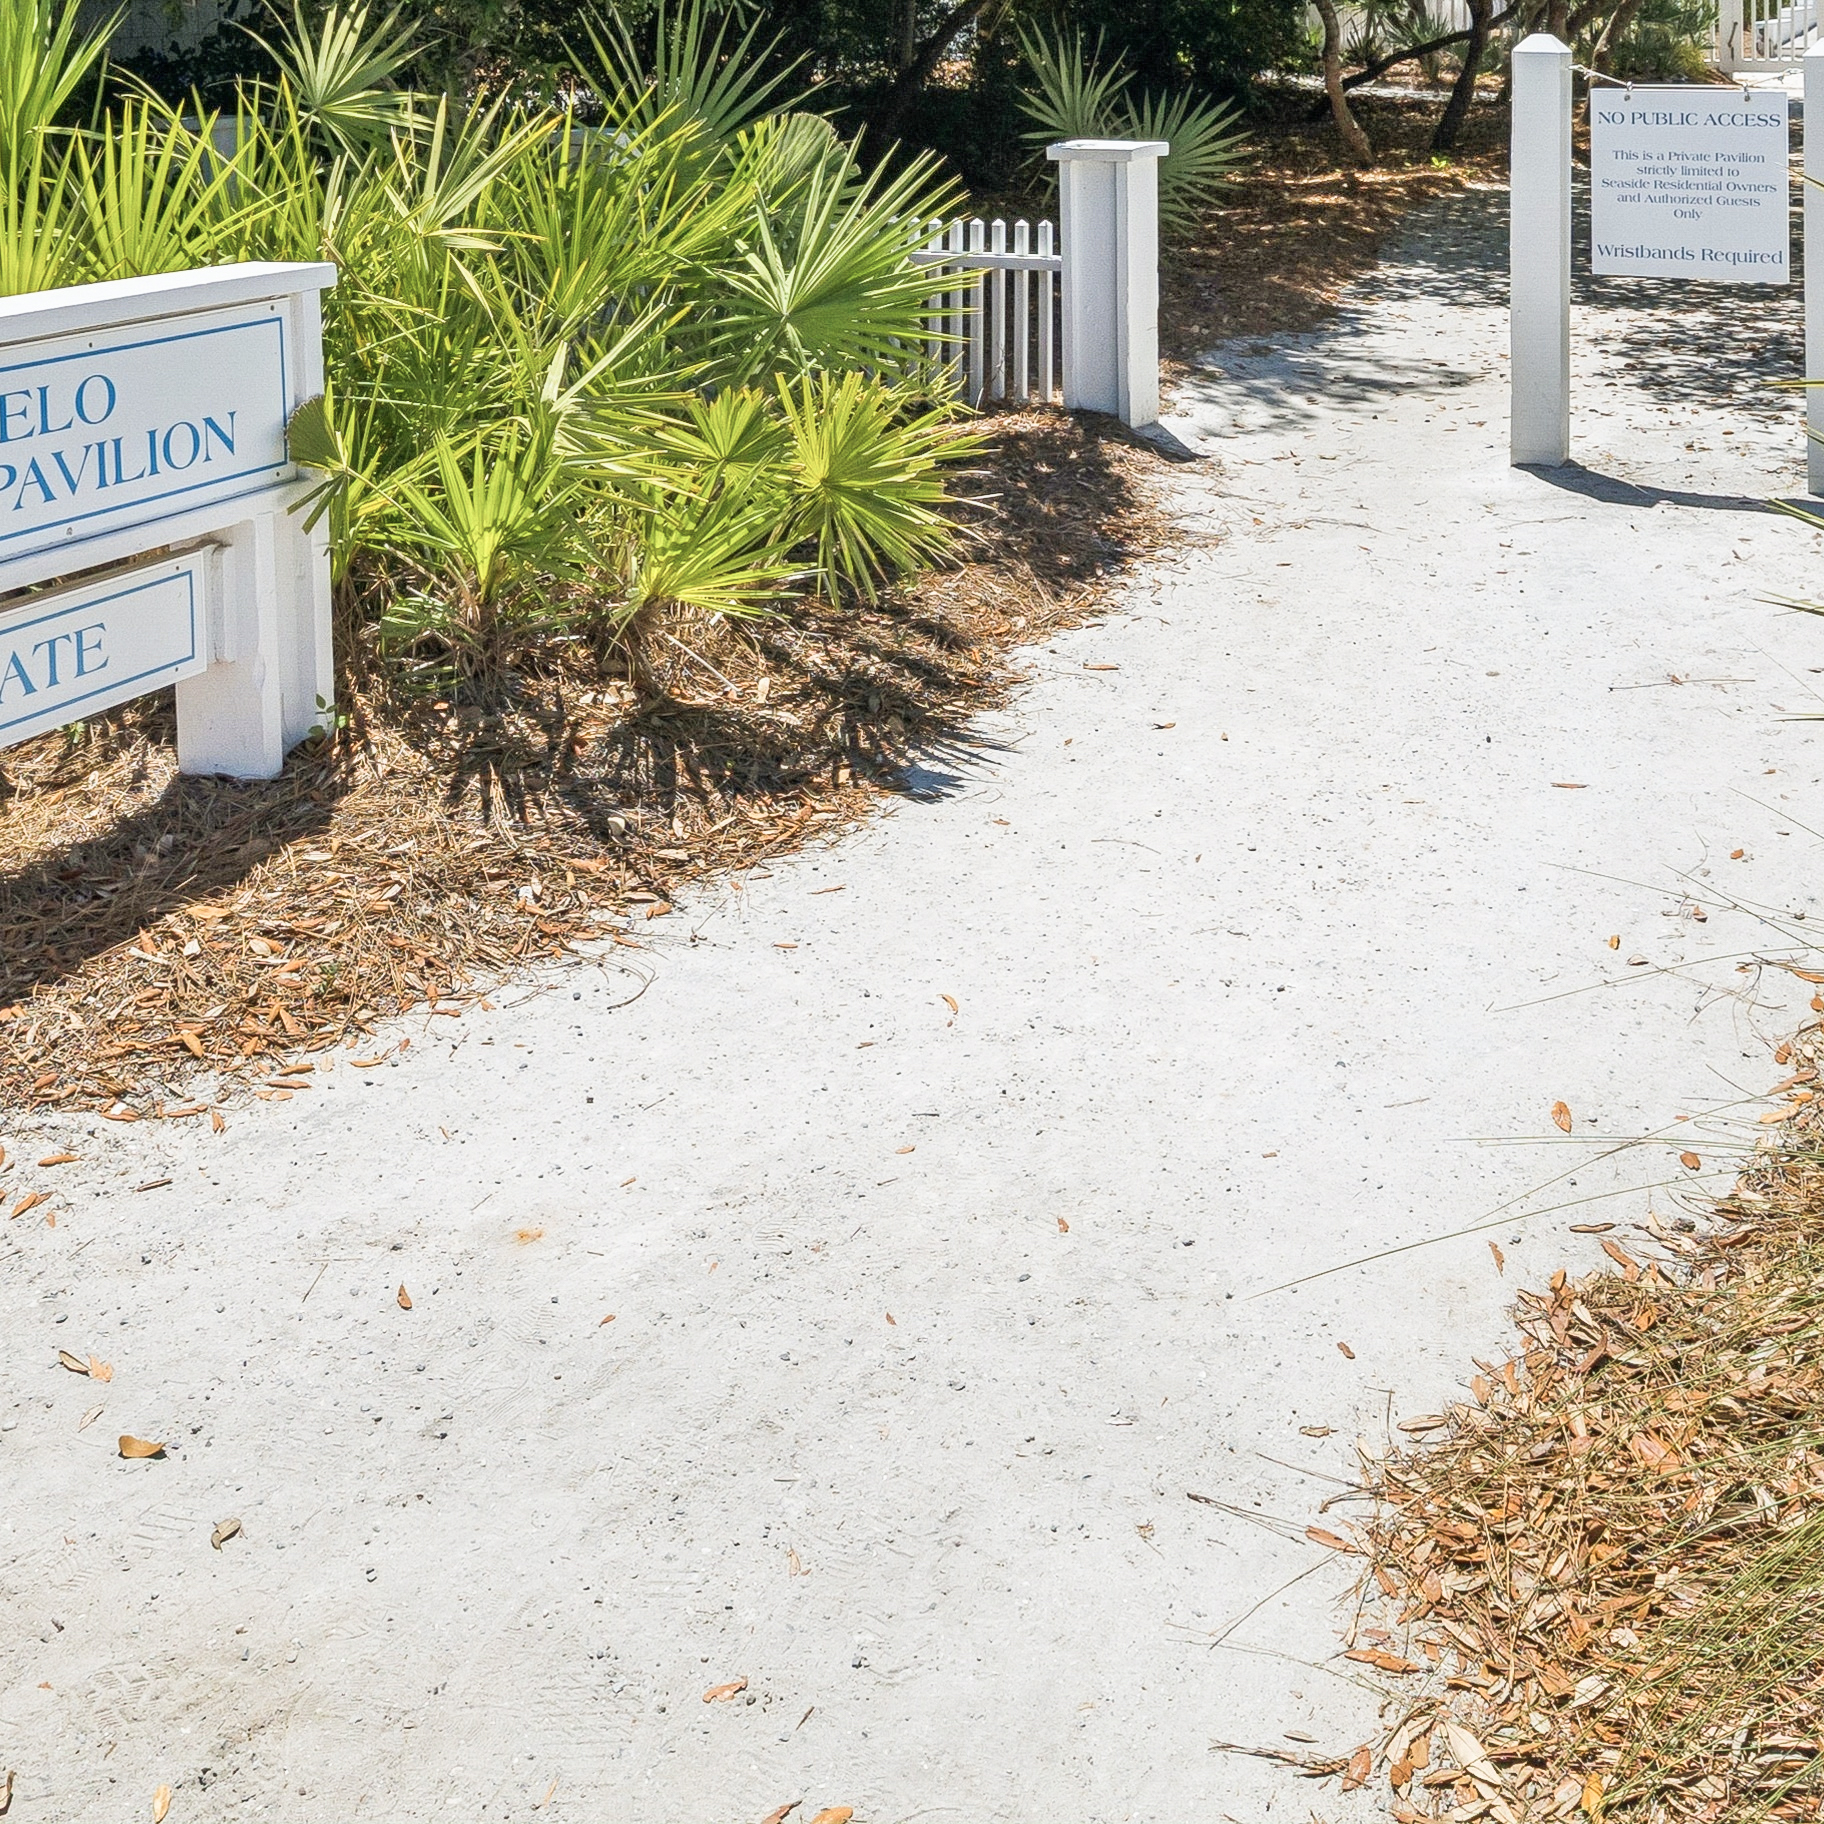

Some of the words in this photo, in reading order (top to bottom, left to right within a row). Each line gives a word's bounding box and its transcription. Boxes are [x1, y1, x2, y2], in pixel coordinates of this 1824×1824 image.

[1598, 111, 1625, 125] NO
[1631, 112, 1698, 126] PUBLIC
[1703, 113, 1781, 127] ACCESS
[1613, 150, 1638, 161] This
[1643, 151, 1653, 161] is
[1656, 153, 1665, 161] a
[1668, 151, 1710, 163] Private
[1715, 152, 1765, 163] Pavilion
[1636, 164, 1677, 177] strictly
[1681, 165, 1723, 176] limited
[1727, 168, 1739, 177] to
[1602, 178, 1650, 190] Seaside
[1654, 179, 1722, 191] Residential
[1726, 181, 1777, 193] Owners
[1617, 192, 1641, 204] and
[1644, 193, 1712, 206] Authorized
[1716, 196, 1761, 207] Guests
[1674, 208, 1703, 220] Only
[1597, 244, 1695, 261] Wristbands
[1701, 248, 1783, 266] Required
